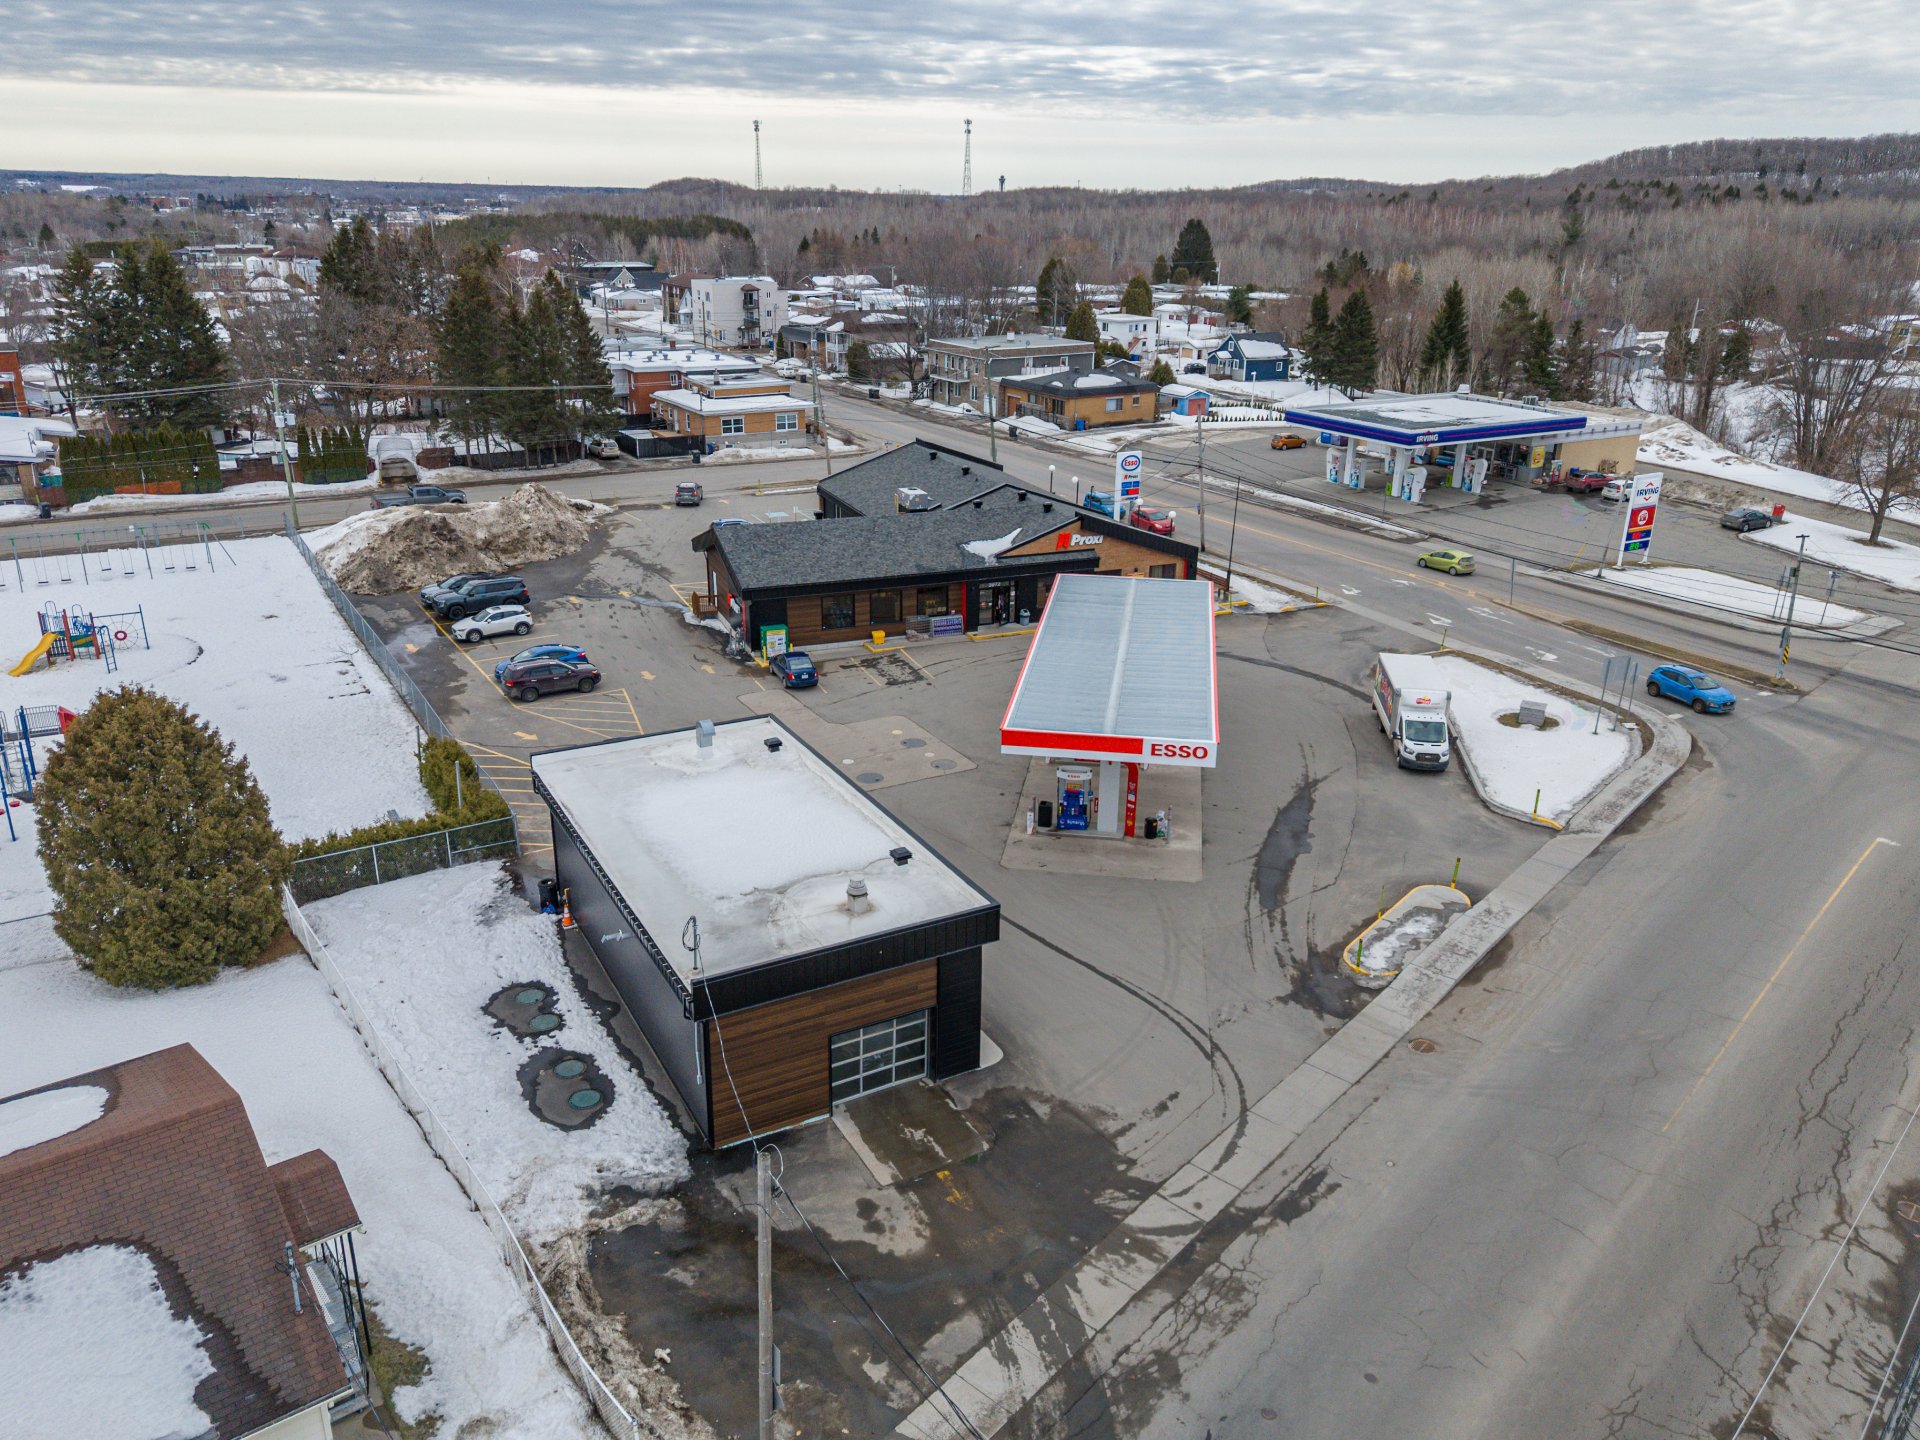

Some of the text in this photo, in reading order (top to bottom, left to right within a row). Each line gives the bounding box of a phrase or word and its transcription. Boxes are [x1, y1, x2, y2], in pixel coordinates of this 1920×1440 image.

[1416, 434, 1438, 443] IRVING
[1637, 487, 1659, 497] IRVING
[1071, 534, 1104, 546] Proxi
[1151, 743, 1208, 760] ESSO
